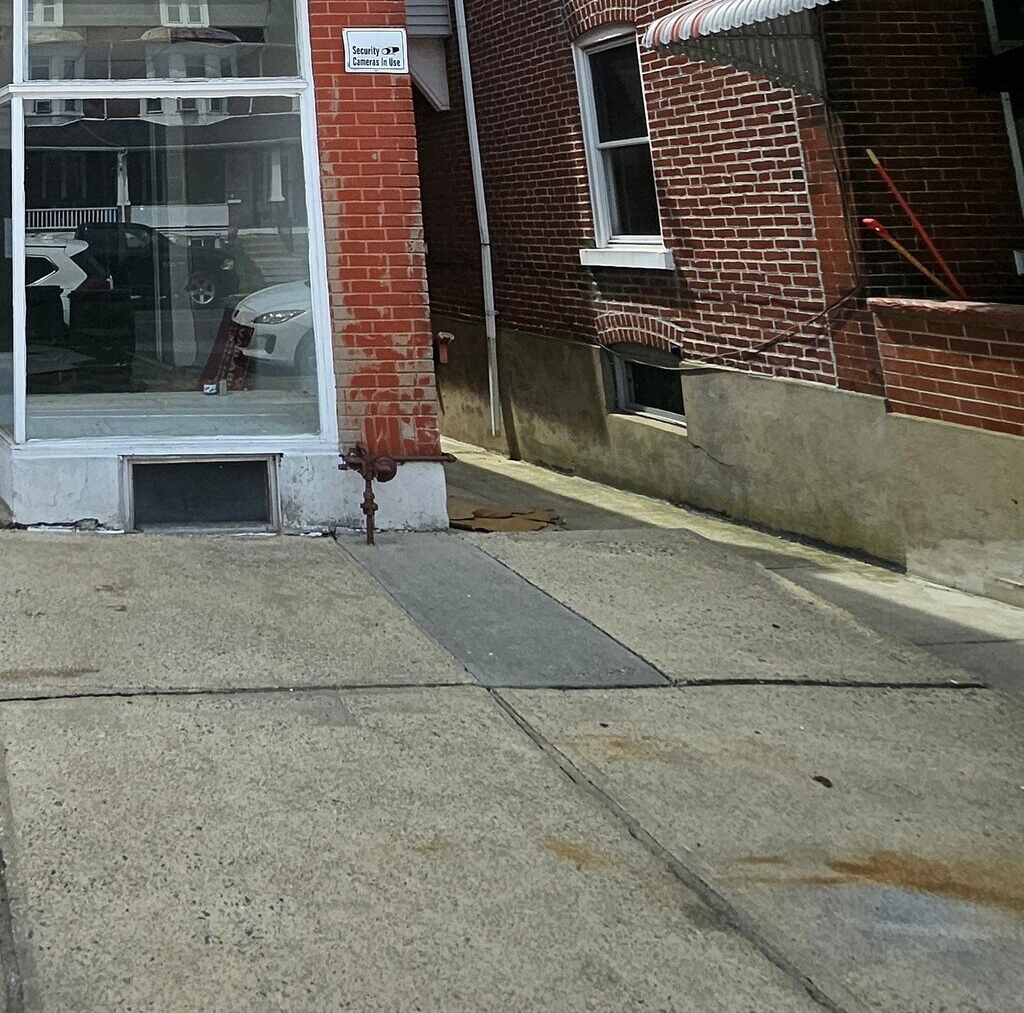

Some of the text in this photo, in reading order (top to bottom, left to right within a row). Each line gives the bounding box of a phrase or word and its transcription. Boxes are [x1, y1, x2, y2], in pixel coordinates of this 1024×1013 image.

[352, 45, 380, 57] Security
[352, 57, 401, 67] Cameras In Use
